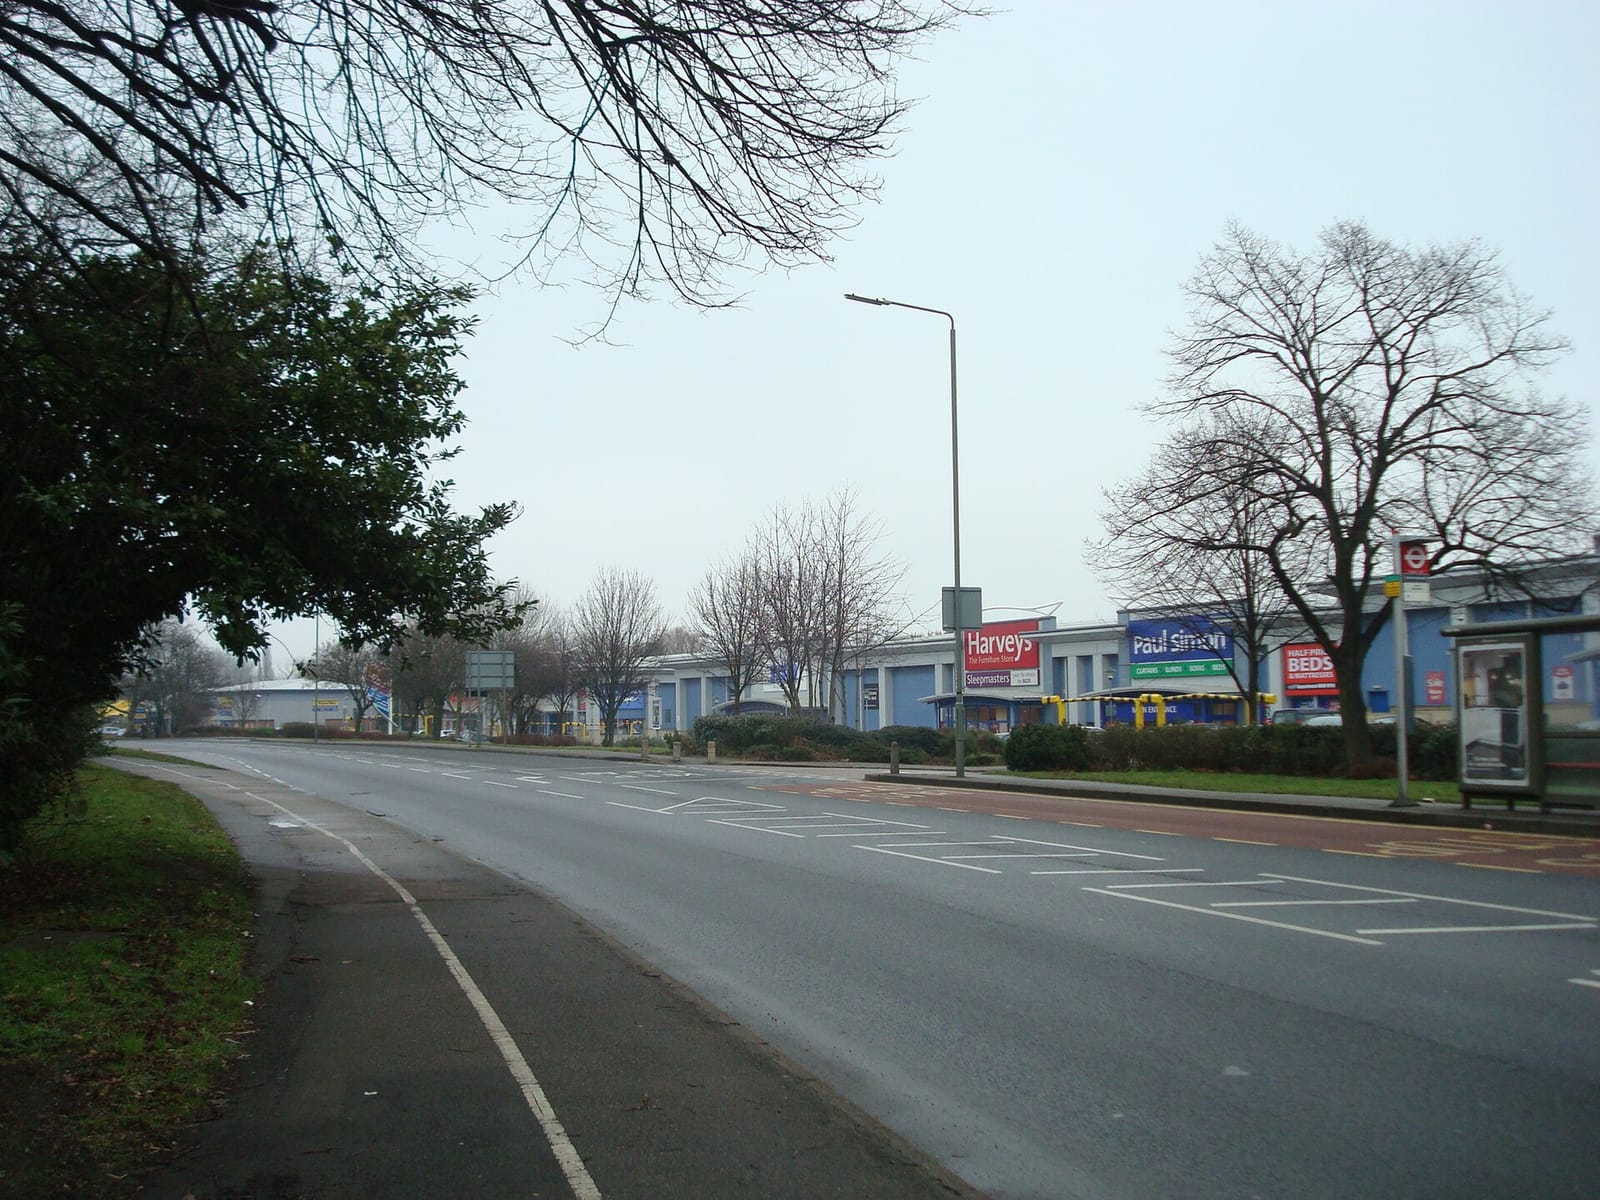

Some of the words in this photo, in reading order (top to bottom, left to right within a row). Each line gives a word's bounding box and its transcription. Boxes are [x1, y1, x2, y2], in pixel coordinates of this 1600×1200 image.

[967, 632, 1033, 662] Harveys
[1133, 629, 1168, 655] Paul
[968, 656, 978, 664] The
[1287, 649, 1310, 657] HALF
[1287, 656, 1334, 672] BEDS
[966, 673, 1010, 686] Sleepmasters
